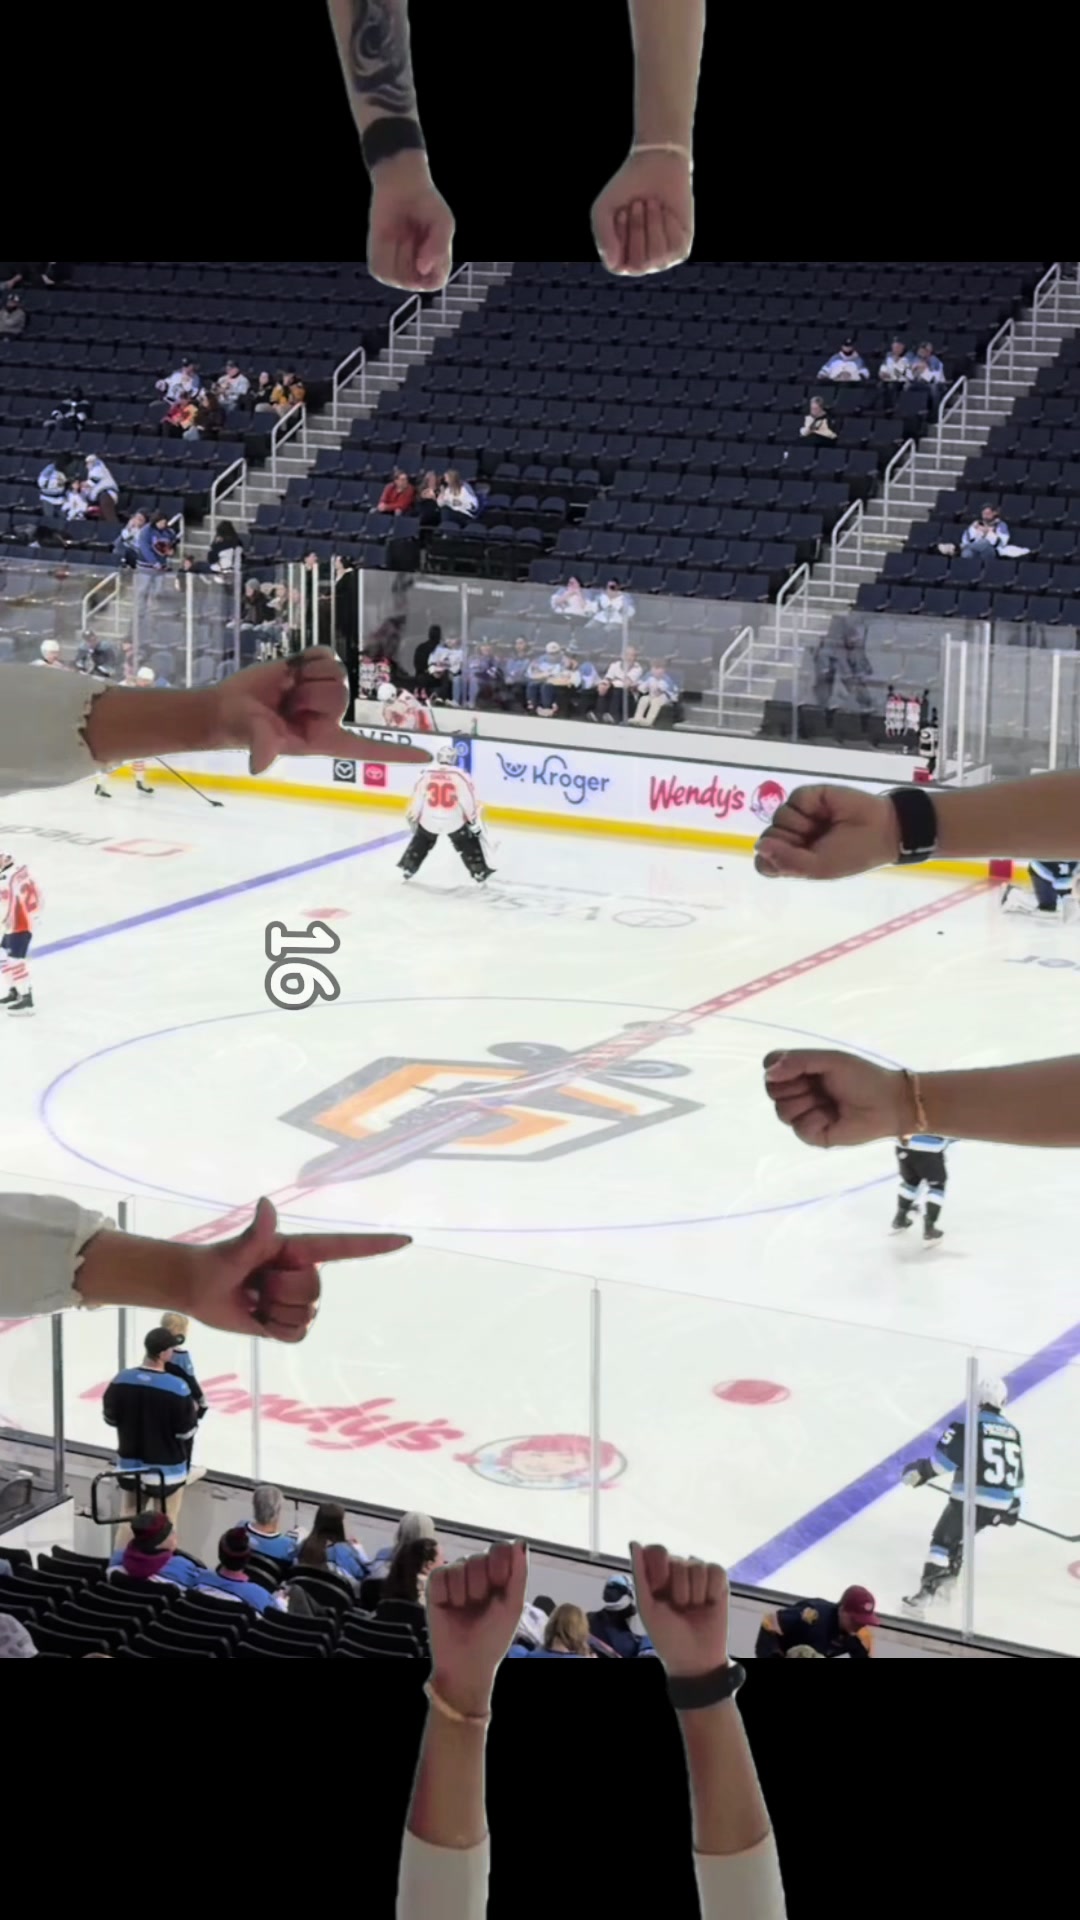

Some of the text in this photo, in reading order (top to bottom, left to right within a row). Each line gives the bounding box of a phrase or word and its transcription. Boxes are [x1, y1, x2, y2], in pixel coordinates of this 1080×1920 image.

[532, 755, 611, 804] Kroger
[649, 776, 745, 818] Wendy's
[983, 1438, 1021, 1486] 55
